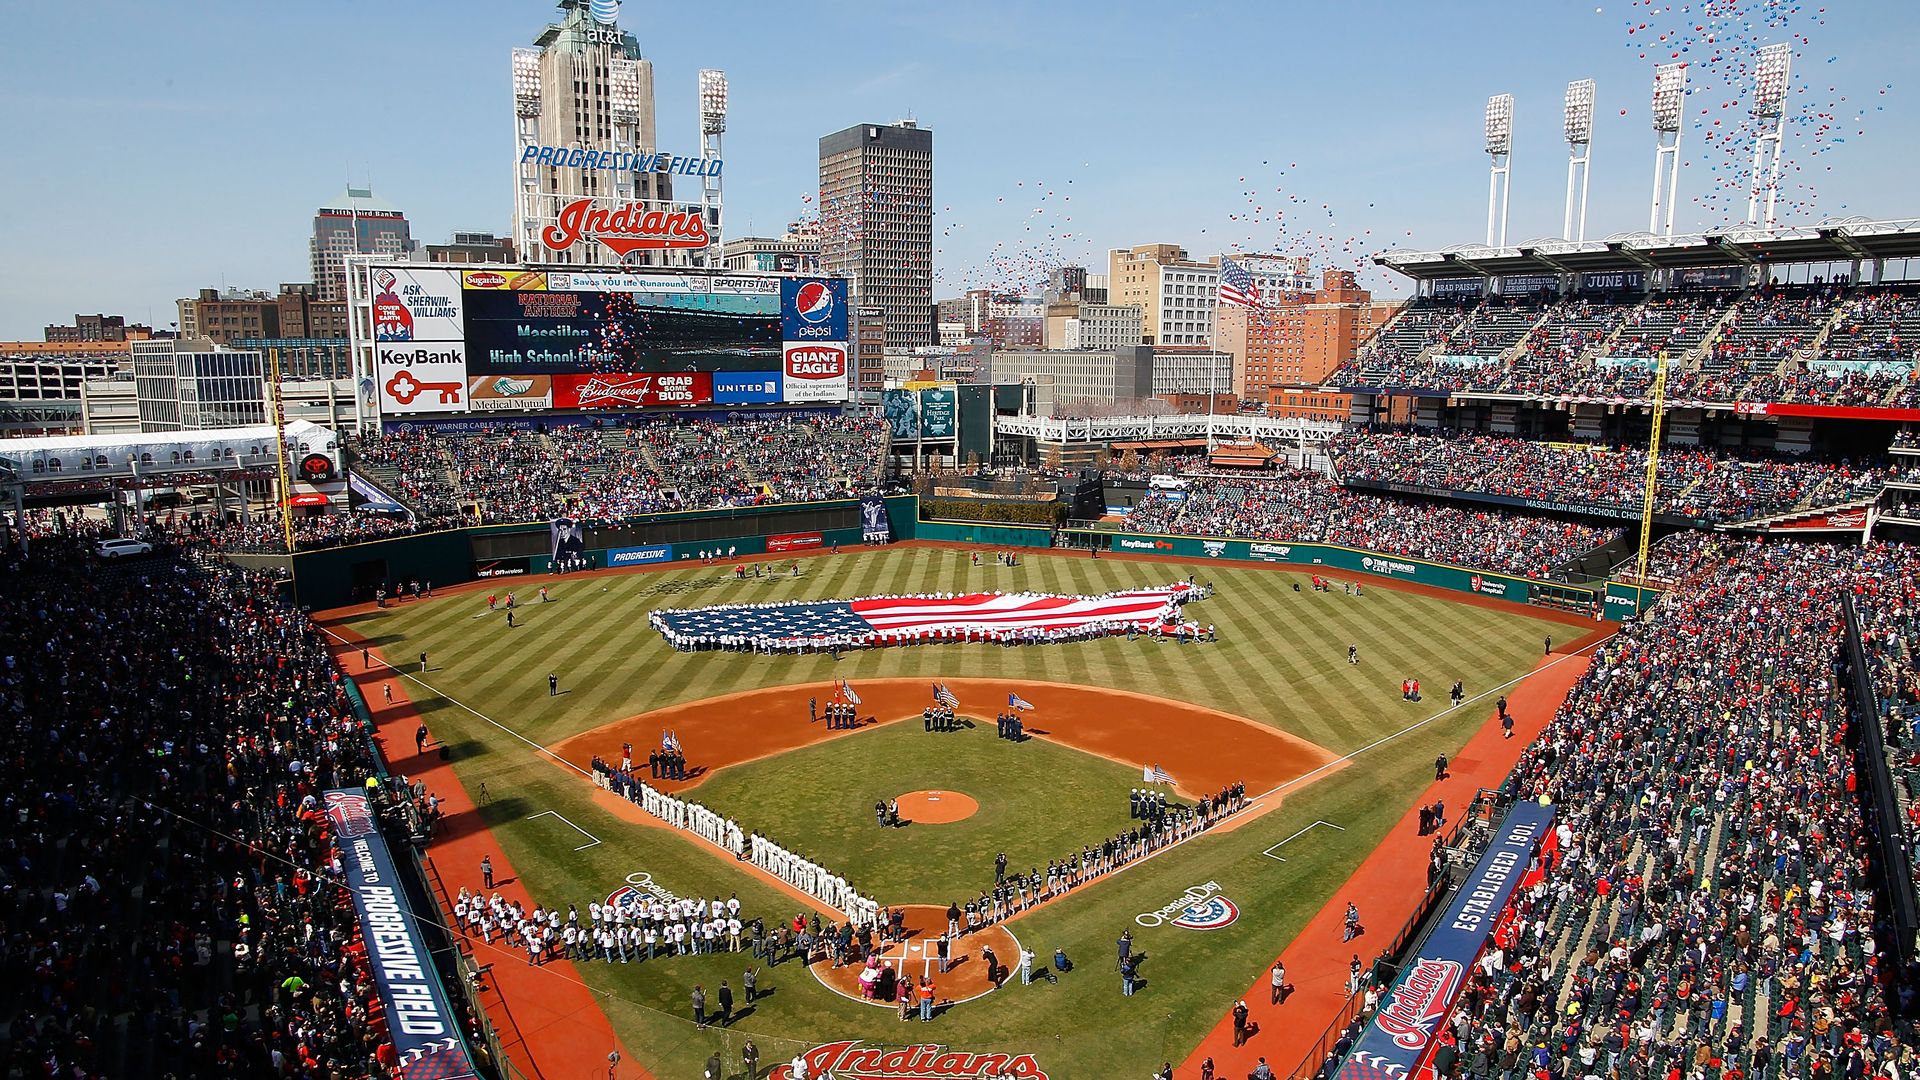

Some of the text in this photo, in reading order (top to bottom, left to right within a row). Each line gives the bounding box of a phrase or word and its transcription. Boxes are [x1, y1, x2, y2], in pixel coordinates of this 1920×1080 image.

[587, 29, 623, 45] at&t
[520, 145, 723, 177] PROGRESSIVE FIELD
[542, 199, 710, 251] Indians
[467, 274, 506, 287] Sugardale
[602, 279, 621, 287] YOU
[1587, 275, 1623, 288] JUNE
[402, 285, 421, 296] ASK
[407, 296, 452, 307] SHERWIN-
[518, 293, 581, 306] NATIONAL
[413, 307, 457, 318] WILLIAMS
[523, 305, 577, 318] ANTHEM
[798, 325, 832, 338] pepsi
[381, 349, 463, 367] KeyBank
[791, 352, 840, 363] GIANT
[792, 363, 839, 374] EAGLE
[657, 376, 693, 386] GRAB
[785, 382, 845, 391] Official supermarket
[576, 384, 650, 398] Budweiser
[717, 384, 763, 392] UNITED
[658, 391, 693, 401] BUDS
[475, 399, 547, 410] Medical Mutual
[435, 422, 468, 430] WARNER
[470, 421, 494, 429] CABLE
[1525, 499, 1568, 512] MASSILLON
[1568, 504, 1588, 514] HIGH
[1588, 506, 1620, 518] SCHOOL
[1121, 539, 1155, 549] KeyBank
[1250, 543, 1291, 555] FirstEnergy
[613, 549, 667, 562] PROGRESSIVE
[1372, 566, 1392, 574] CABLE
[1373, 558, 1416, 571] TIME WARNER
[1480, 586, 1504, 595] Hospitals
[1481, 580, 1507, 591] University
[1604, 595, 1628, 605] STO
[353, 838, 380, 883] WELCOME TO
[1452, 851, 1519, 932] ESTABLISHED
[1135, 880, 1222, 927] Opening Day
[358, 885, 445, 1036] PROGRESSIVE FIELD
[1375, 957, 1457, 1050] Indians
[768, 1039, 1049, 1080] Indians
